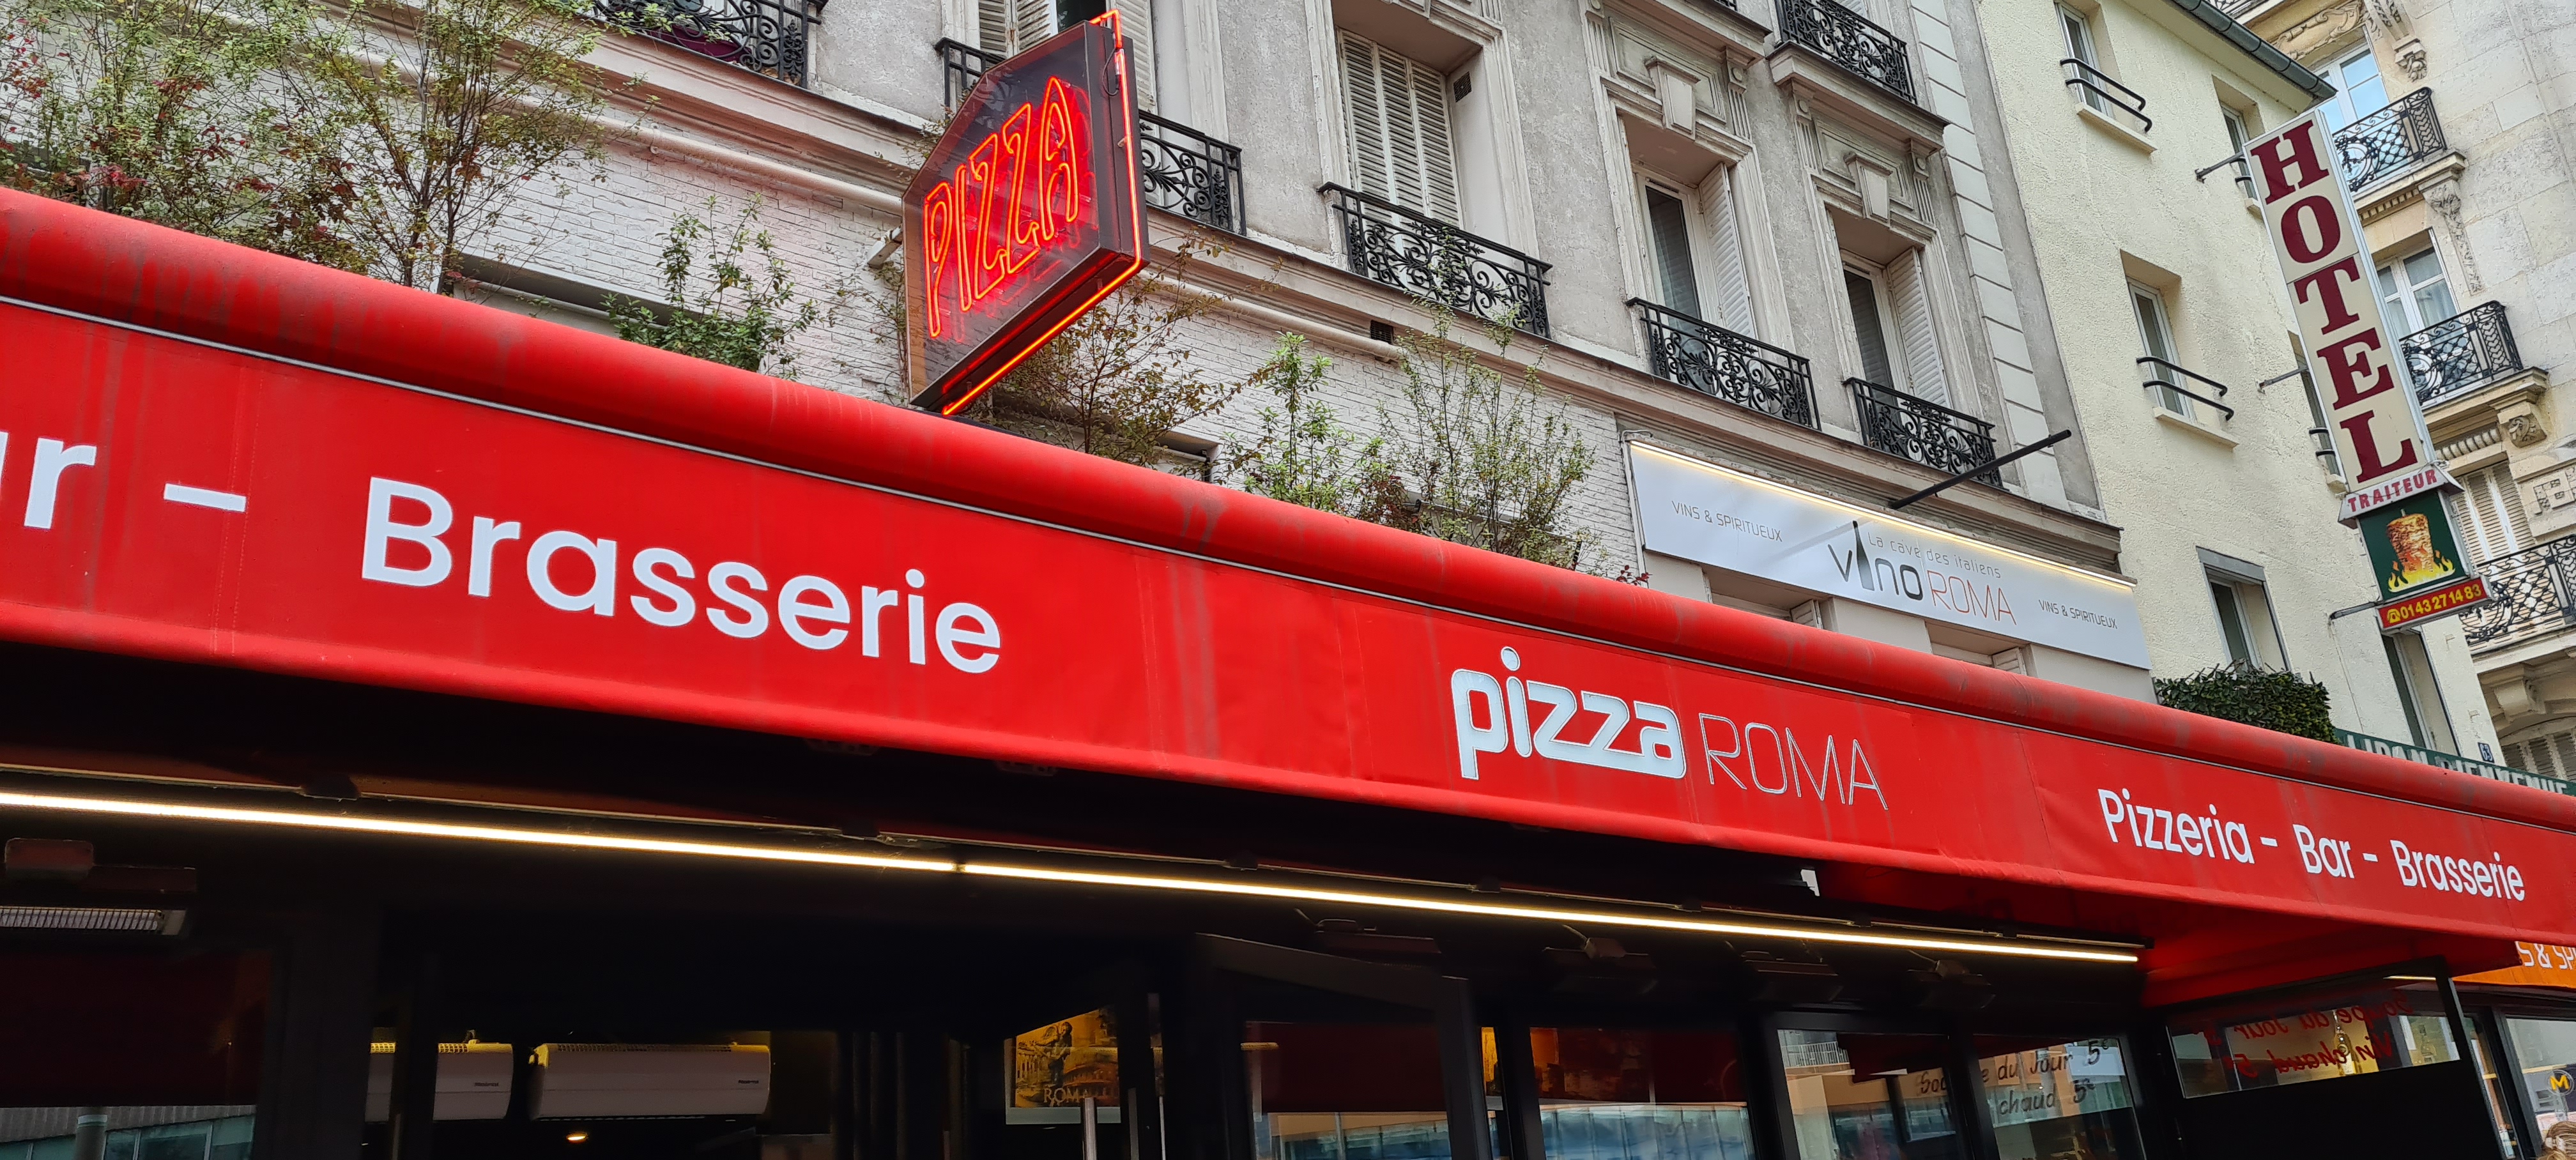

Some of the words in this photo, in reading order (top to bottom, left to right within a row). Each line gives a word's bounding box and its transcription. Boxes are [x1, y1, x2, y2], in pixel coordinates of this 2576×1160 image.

[923, 75, 1079, 339] PIZZA
[2251, 120, 2418, 484] HOTEL
[2347, 469, 2438, 512] TRAITEUR
[1671, 500, 1700, 520] VINS
[1704, 510, 1713, 524] &
[1716, 513, 1783, 542] SPIRITUEUX
[0, 431, 98, 530] r
[362, 477, 1000, 674] Brasserie
[1867, 532, 1883, 548] La
[1890, 540, 1921, 558] cave
[1927, 549, 1949, 565] des
[1954, 554, 2002, 579] italiens
[1927, 570, 2017, 625] ROMA
[2038, 599, 2059, 614] VINS
[2061, 605, 2068, 616] &
[2069, 607, 2118, 629] SPIRITUEUX
[1450, 646, 1687, 781] pizza
[1698, 712, 1889, 811] ROMA
[2479, 743, 2493, 761] 63
[2097, 788, 2255, 864] Pizzeria
[2292, 823, 2355, 879] Bar
[2389, 839, 2526, 902] Brasserie
[2534, 943, 2552, 968] &
[2550, 1074, 2571, 1090] M
